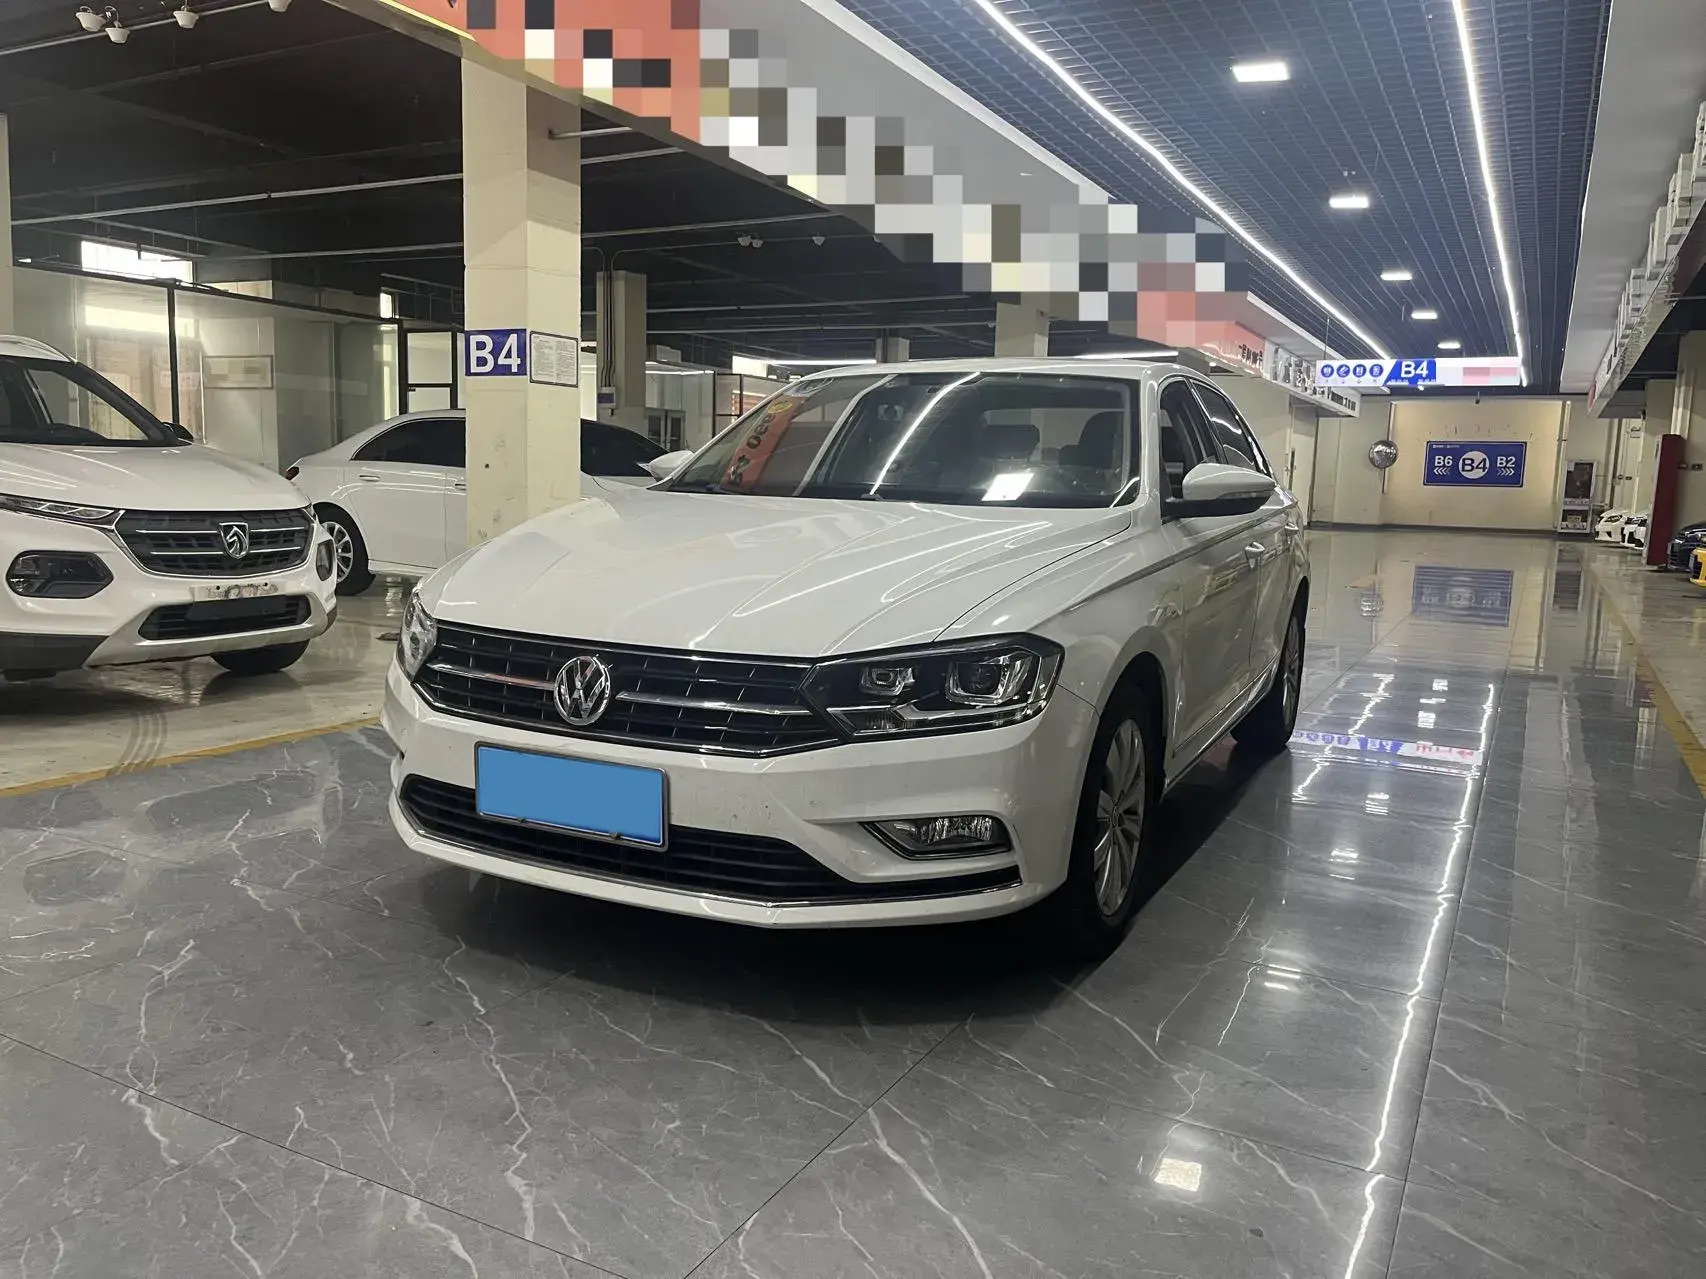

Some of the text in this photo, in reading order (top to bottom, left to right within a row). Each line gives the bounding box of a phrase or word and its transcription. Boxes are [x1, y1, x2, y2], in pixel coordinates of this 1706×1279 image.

[470, 333, 521, 373] B4
[1400, 361, 1428, 378] B4
[1434, 455, 1453, 467] B6
[1461, 457, 1487, 473] B4
[1497, 456, 1516, 468] B2
